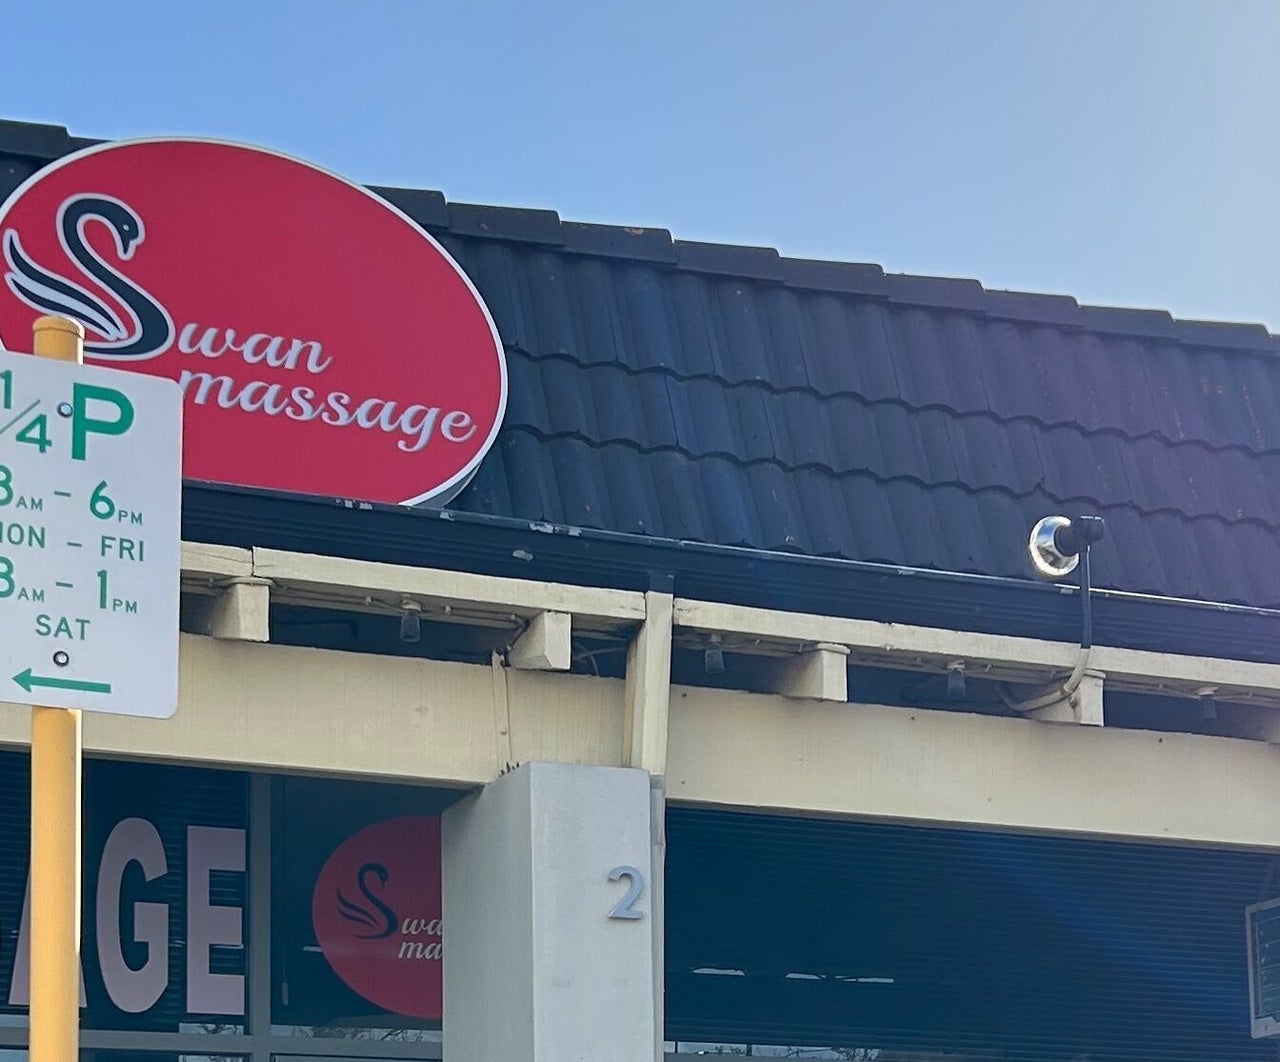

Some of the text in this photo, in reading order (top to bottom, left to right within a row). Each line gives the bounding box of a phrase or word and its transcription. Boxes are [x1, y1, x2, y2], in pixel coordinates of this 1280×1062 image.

[179, 370, 477, 452] massage
[89, 480, 143, 526] 6PM
[100, 536, 145, 562] FRI
[96, 569, 138, 615] 1PM
[34, 614, 91, 641] SAT
[606, 866, 647, 919] 2
